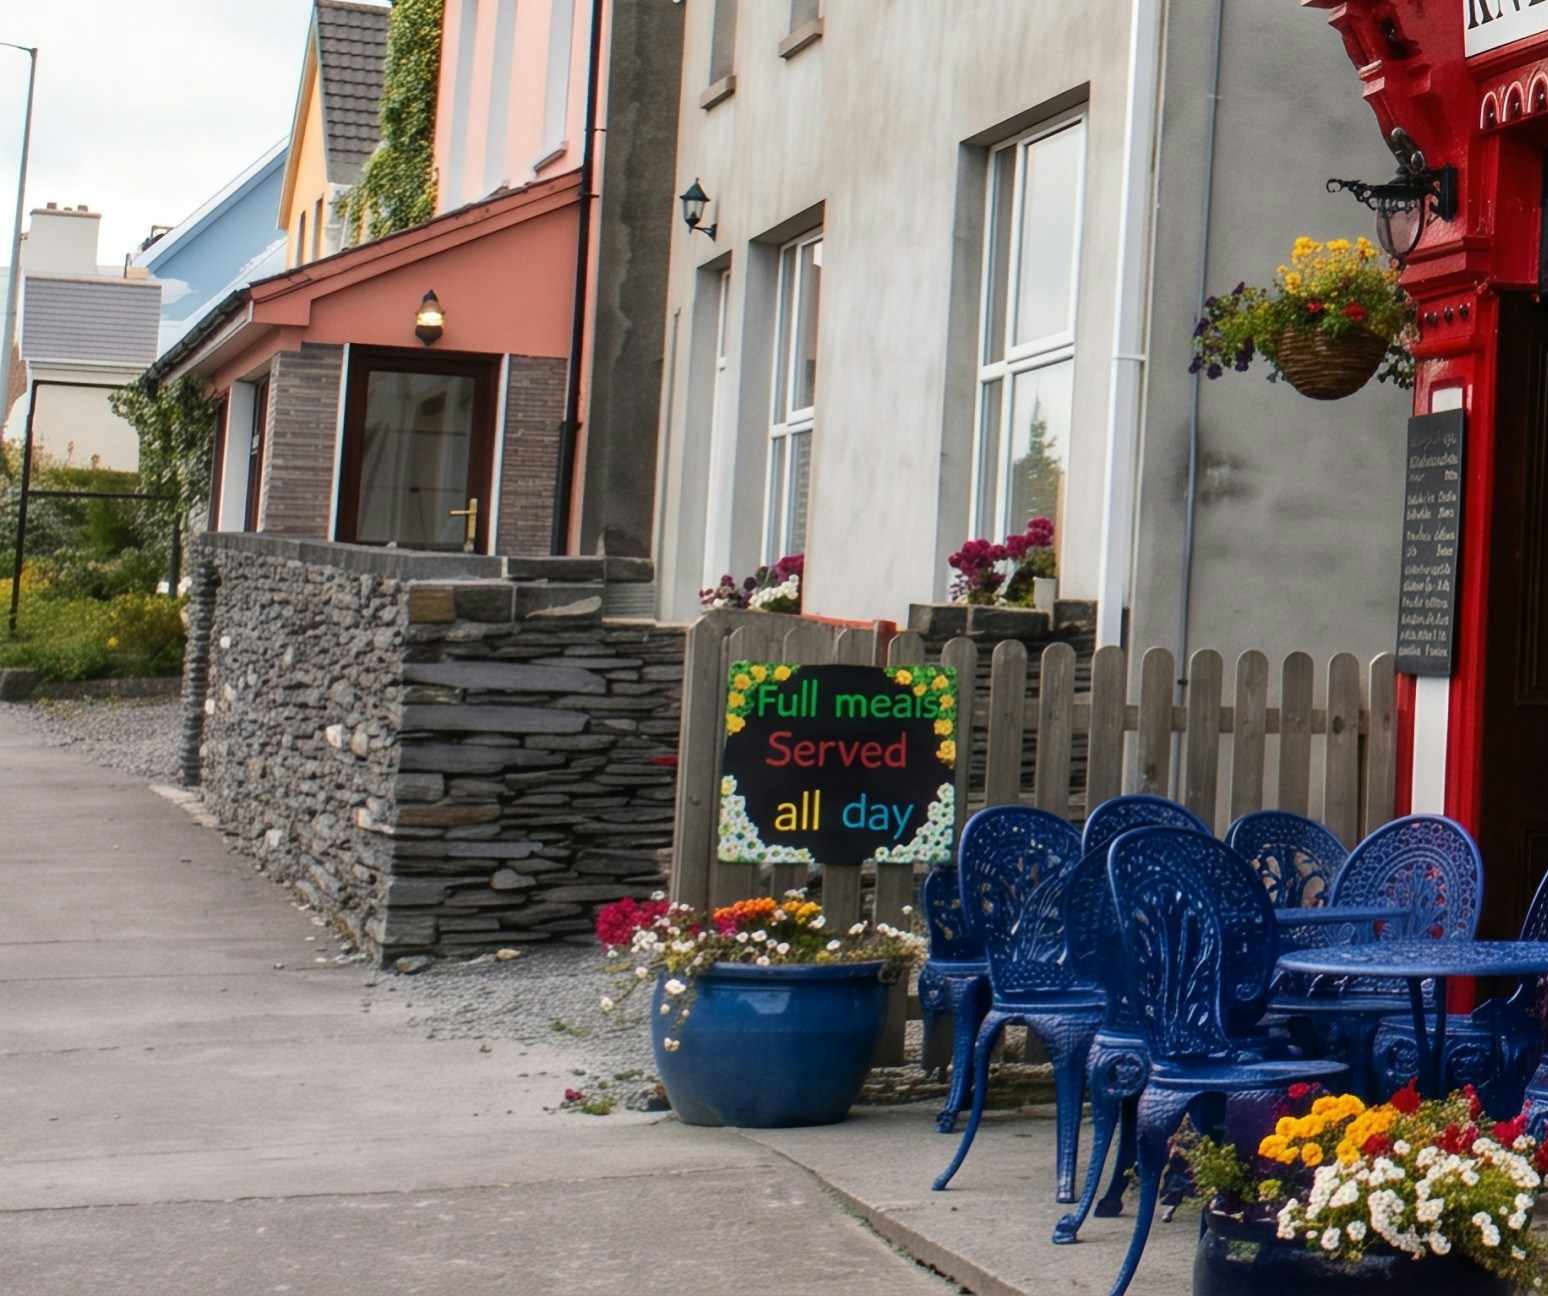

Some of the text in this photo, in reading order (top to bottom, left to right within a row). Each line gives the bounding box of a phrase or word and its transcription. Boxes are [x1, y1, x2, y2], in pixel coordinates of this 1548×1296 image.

[758, 679, 818, 718] Full
[765, 730, 907, 768] Served
[774, 790, 915, 840] all day
